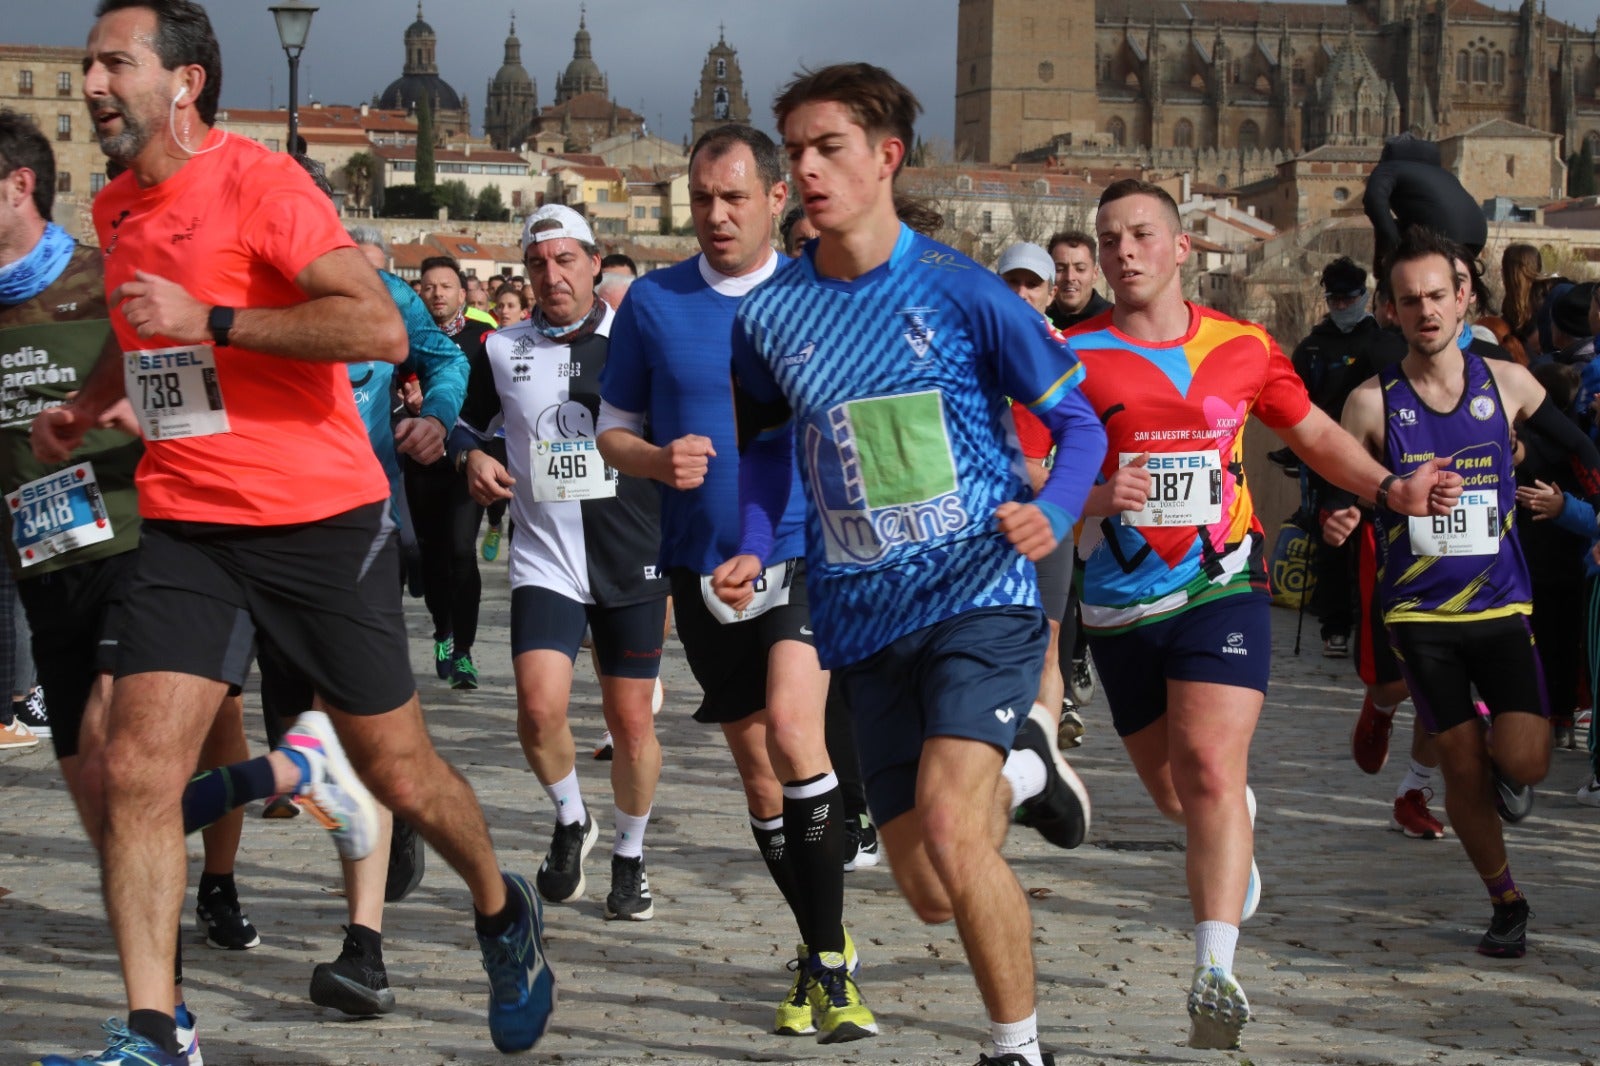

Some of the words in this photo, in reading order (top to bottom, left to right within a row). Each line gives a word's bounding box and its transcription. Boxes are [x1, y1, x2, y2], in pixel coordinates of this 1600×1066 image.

[0, 346, 48, 369] edia
[140, 351, 203, 370] SETEL
[558, 362, 581, 370] 2013
[2, 364, 77, 388] aratón
[558, 370, 581, 378] 2023
[137, 372, 184, 410] 738
[353, 388, 370, 404] ÓN
[1134, 431, 1150, 441] SAN
[1151, 430, 1190, 440] SILVESTRE
[551, 440, 595, 453] SETE
[1401, 451, 1436, 463] Jamón
[1455, 456, 1493, 469] PRIM
[547, 454, 587, 480] 496
[22, 472, 85, 502] SETEL
[1147, 471, 1194, 501] 087
[1461, 474, 1499, 487] acotera
[1457, 494, 1489, 506] TEL
[20, 492, 75, 539] 3418
[839, 494, 967, 547] meins
[1431, 508, 1467, 534] 619
[1222, 646, 1248, 656] saam
